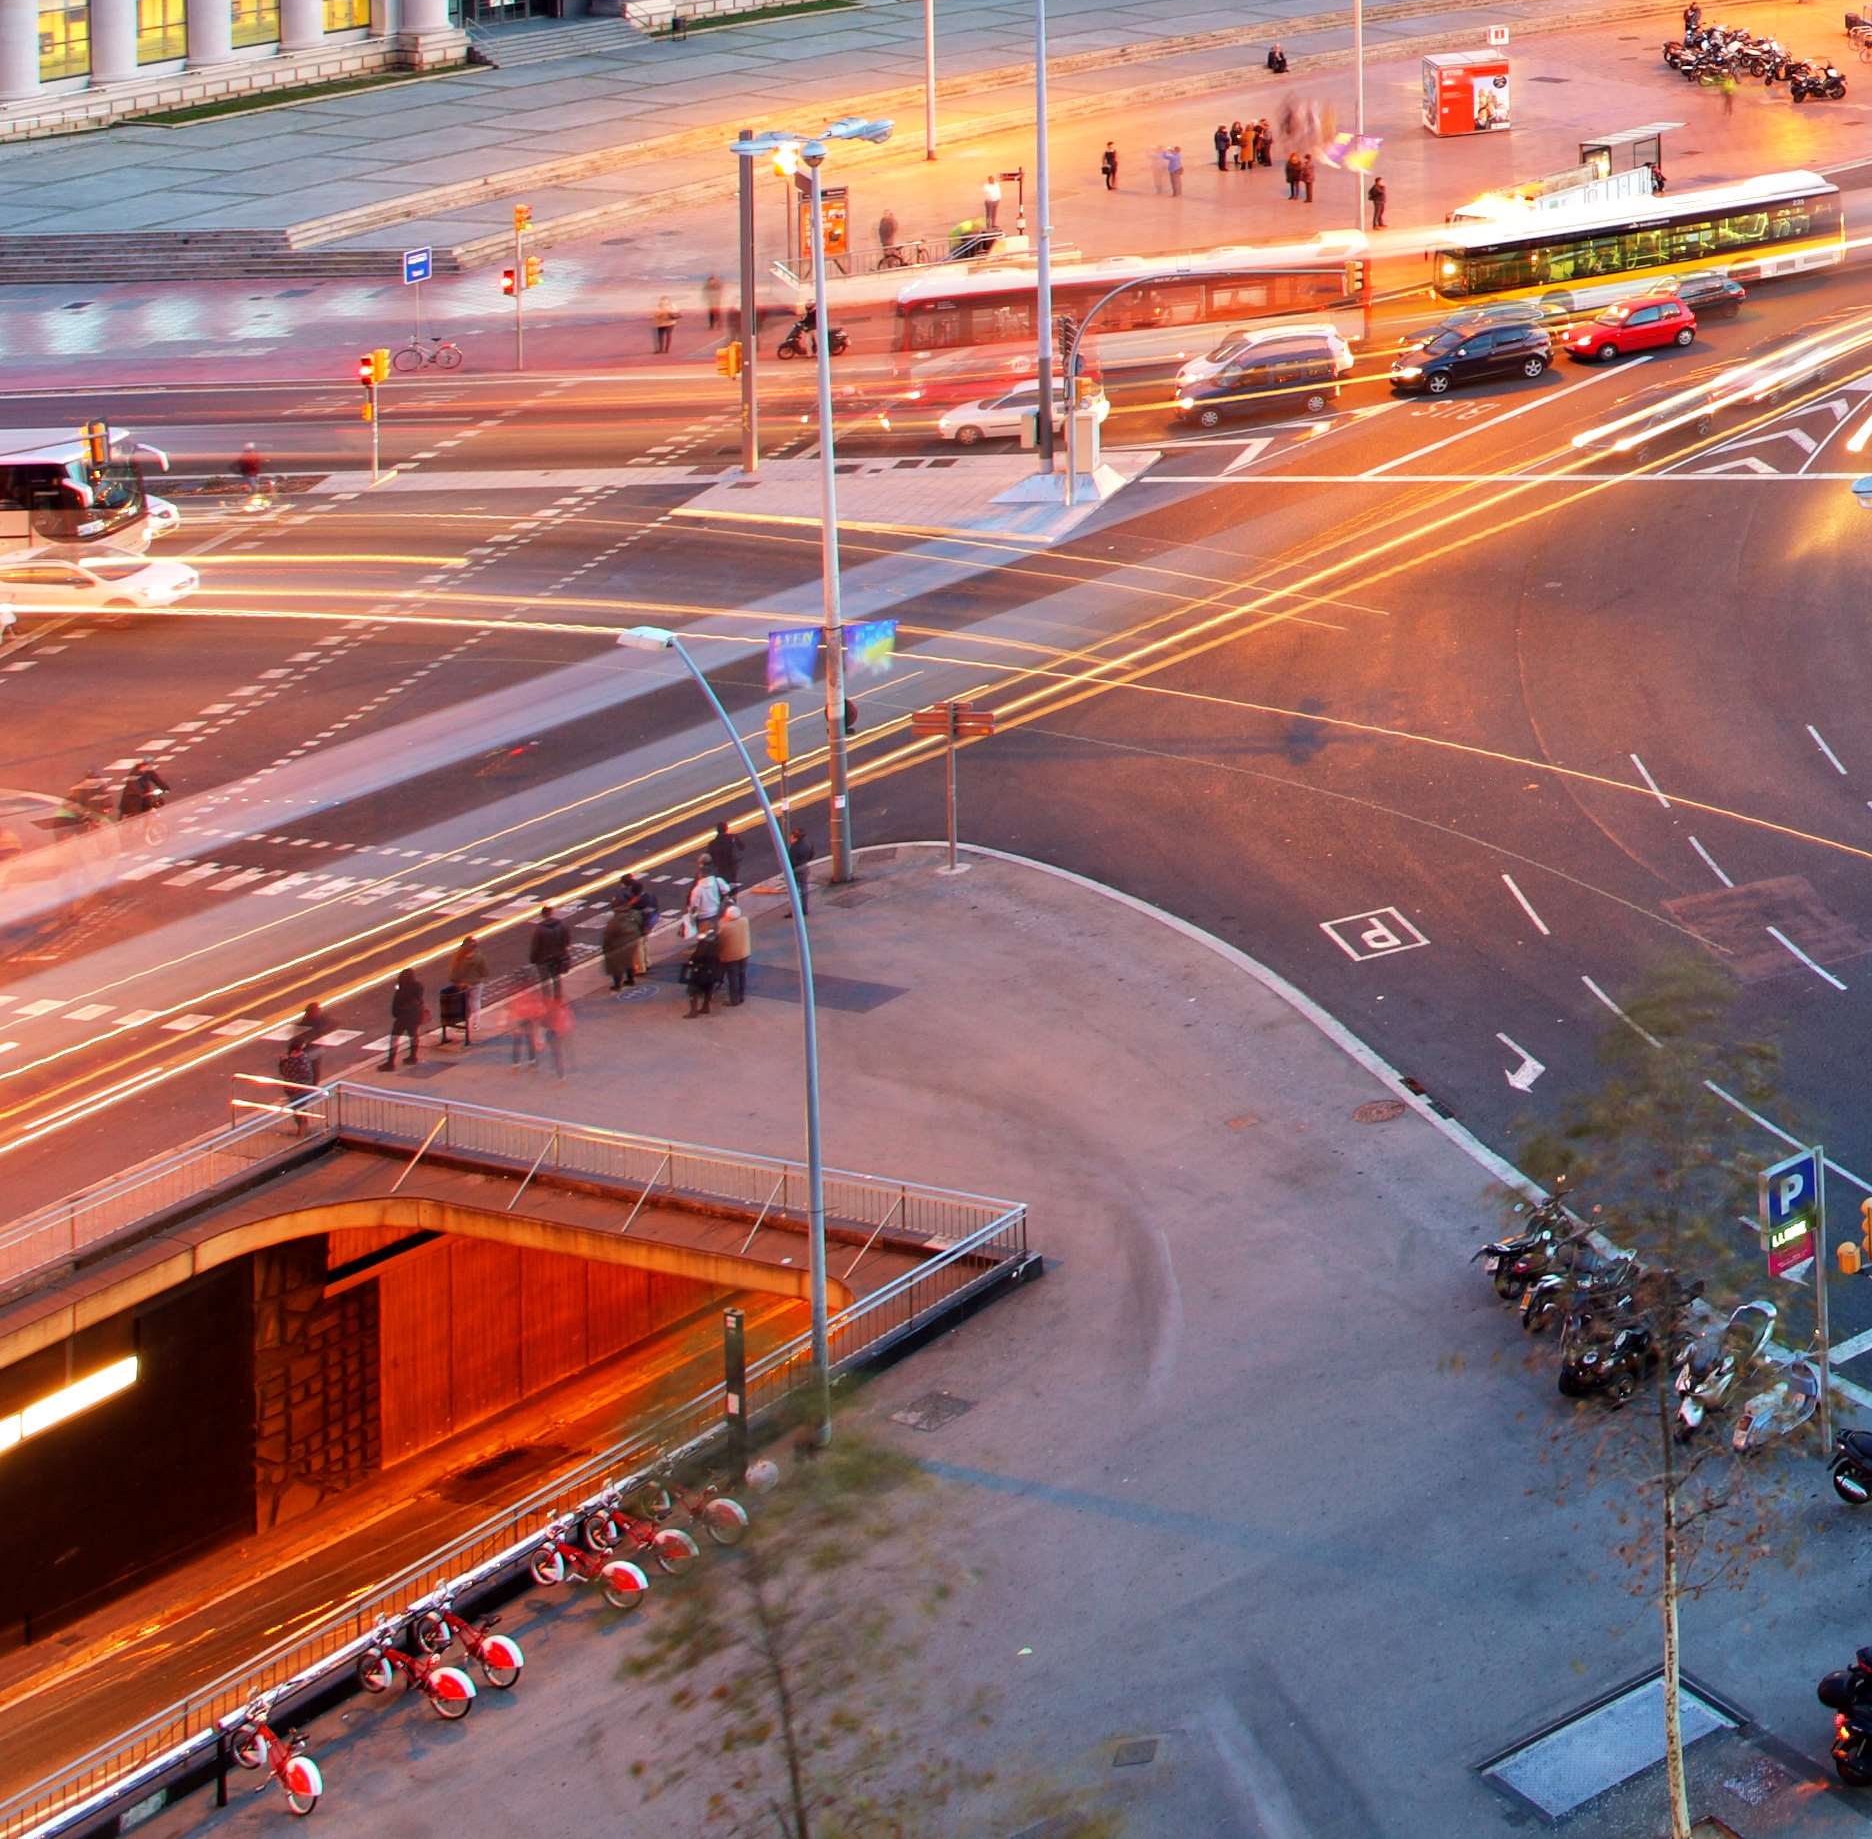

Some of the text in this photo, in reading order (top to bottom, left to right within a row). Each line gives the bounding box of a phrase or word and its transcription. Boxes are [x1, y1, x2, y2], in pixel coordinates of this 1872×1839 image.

[1410, 400, 1501, 421] BUS
[1361, 917, 1402, 948] P
[1781, 1173, 1804, 1216] P
